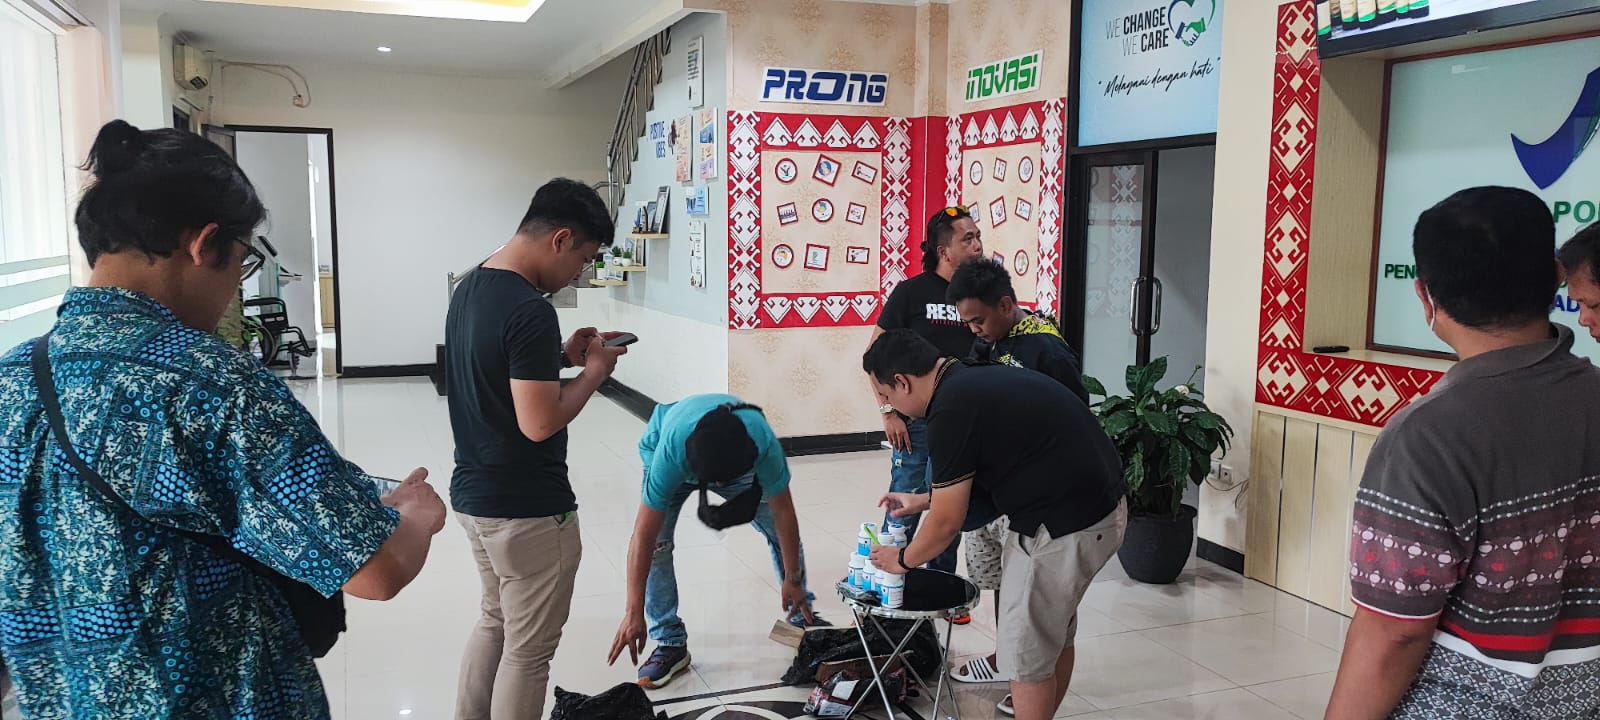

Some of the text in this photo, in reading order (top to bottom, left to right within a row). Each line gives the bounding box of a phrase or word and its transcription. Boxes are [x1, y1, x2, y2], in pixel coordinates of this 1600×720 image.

[1105, 6, 1167, 40] WE CHANGE
[1122, 28, 1170, 56] WE CARE
[762, 68, 888, 103] PRONG
[1151, 67, 1188, 92] dengan
[1189, 57, 1214, 79] hati
[1553, 200, 1600, 223] PO
[1384, 263, 1418, 279] PEN
